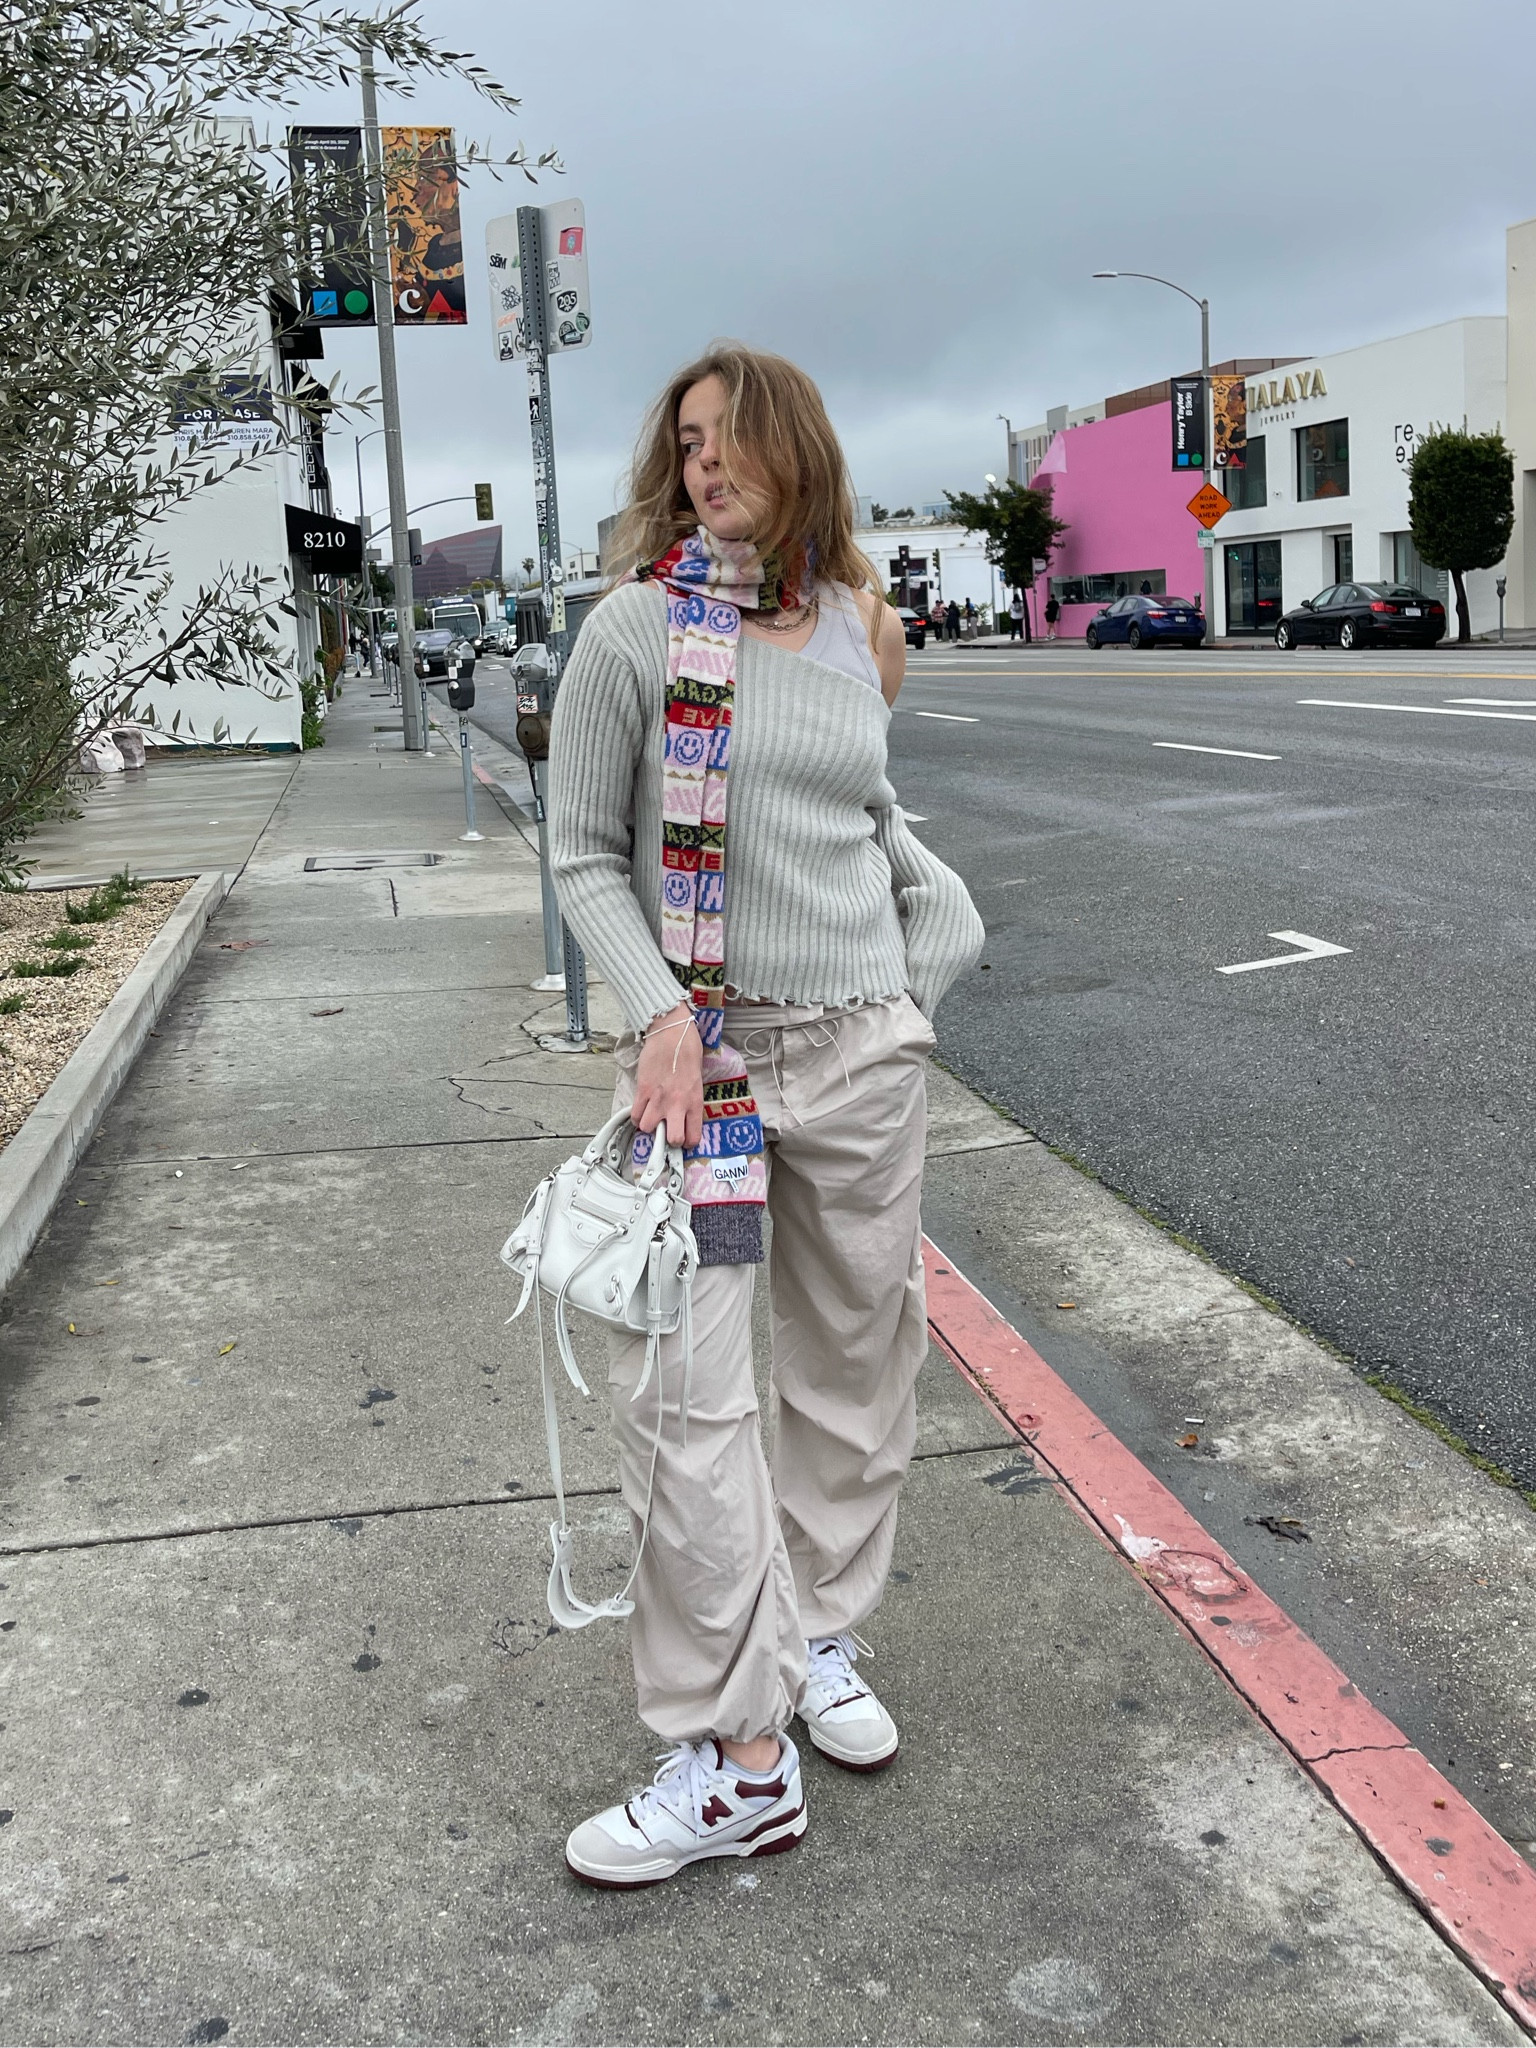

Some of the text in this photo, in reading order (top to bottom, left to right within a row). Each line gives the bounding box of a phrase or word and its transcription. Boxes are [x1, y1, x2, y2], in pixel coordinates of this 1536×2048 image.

[557, 291, 578, 309] 205
[1246, 368, 1328, 413] ALAYA
[184, 408, 261, 420] FOR ASE
[1176, 391, 1186, 450] Henry Taylor
[1260, 411, 1296, 428] JEWELRY
[1199, 511, 1221, 519] AHEAD
[303, 531, 346, 549] 8210
[704, 1098, 757, 1119] LOV
[714, 1165, 748, 1180] GANNI
